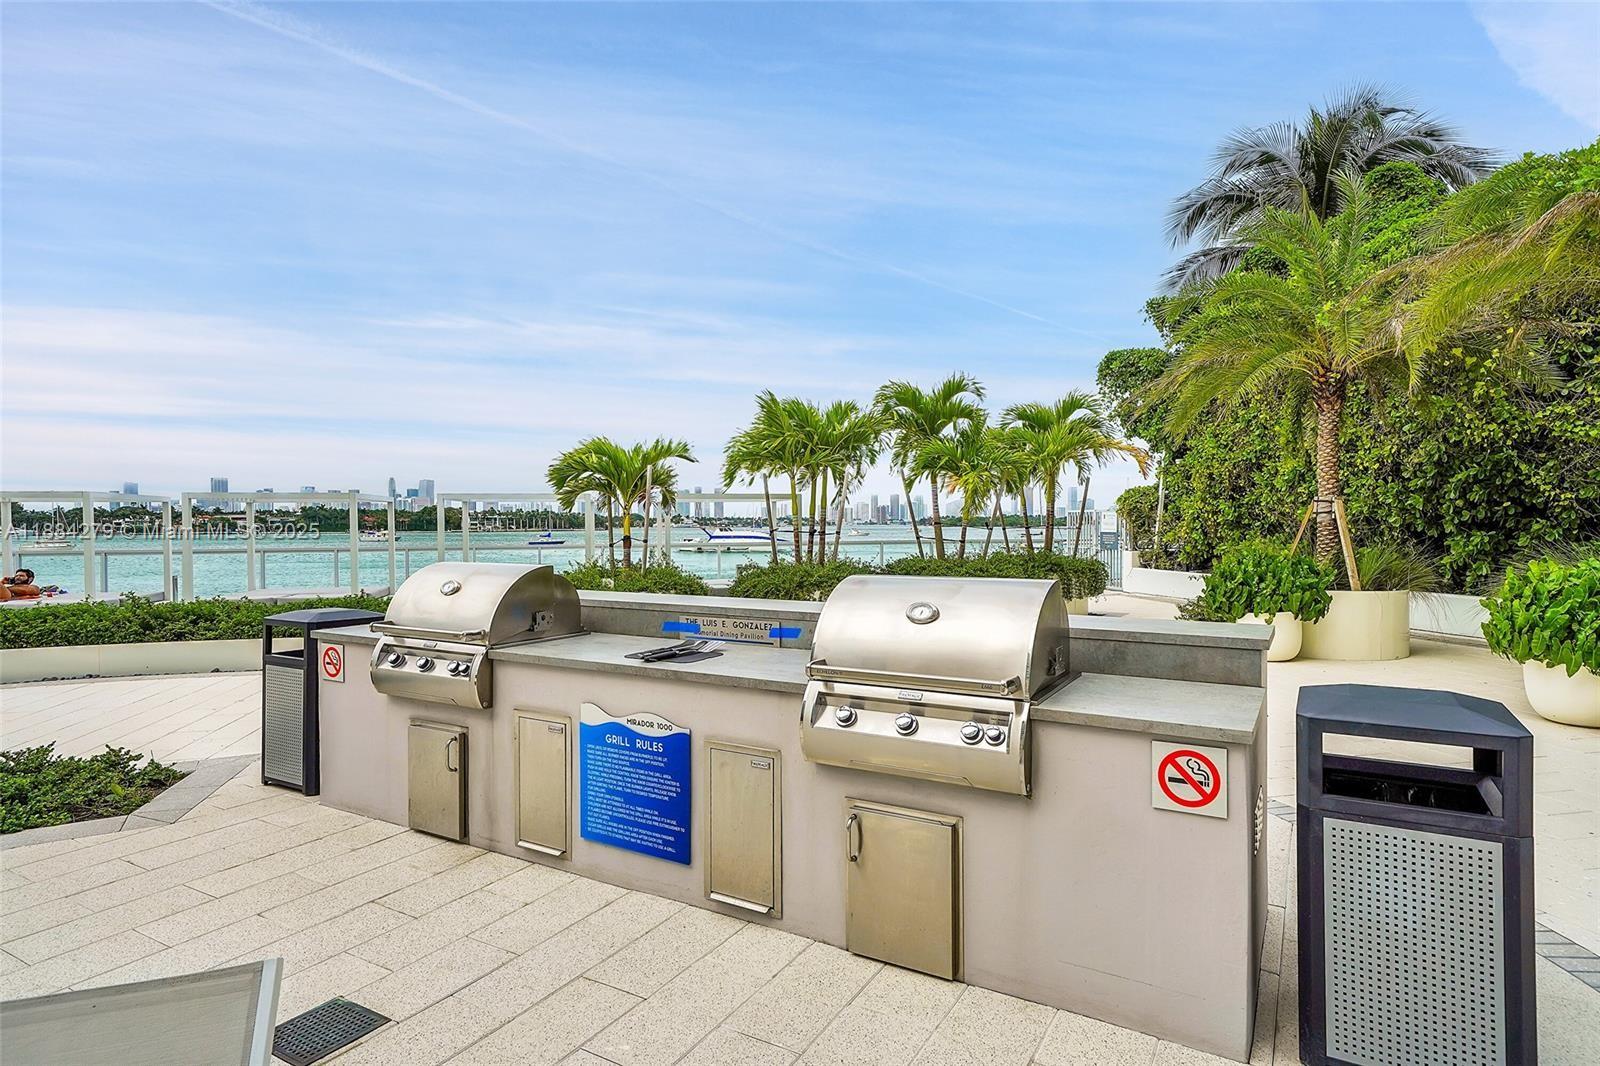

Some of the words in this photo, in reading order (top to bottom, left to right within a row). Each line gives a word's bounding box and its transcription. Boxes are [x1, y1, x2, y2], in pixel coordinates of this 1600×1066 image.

[702, 620, 718, 628] LUIS
[722, 620, 728, 628] E.
[732, 621, 773, 631] GONZALEZ
[720, 631, 738, 640] Dining
[626, 718, 654, 728] MIRADOR
[657, 722, 673, 732] 1000
[605, 734, 630, 747] GRILL
[636, 738, 664, 752] RULES
